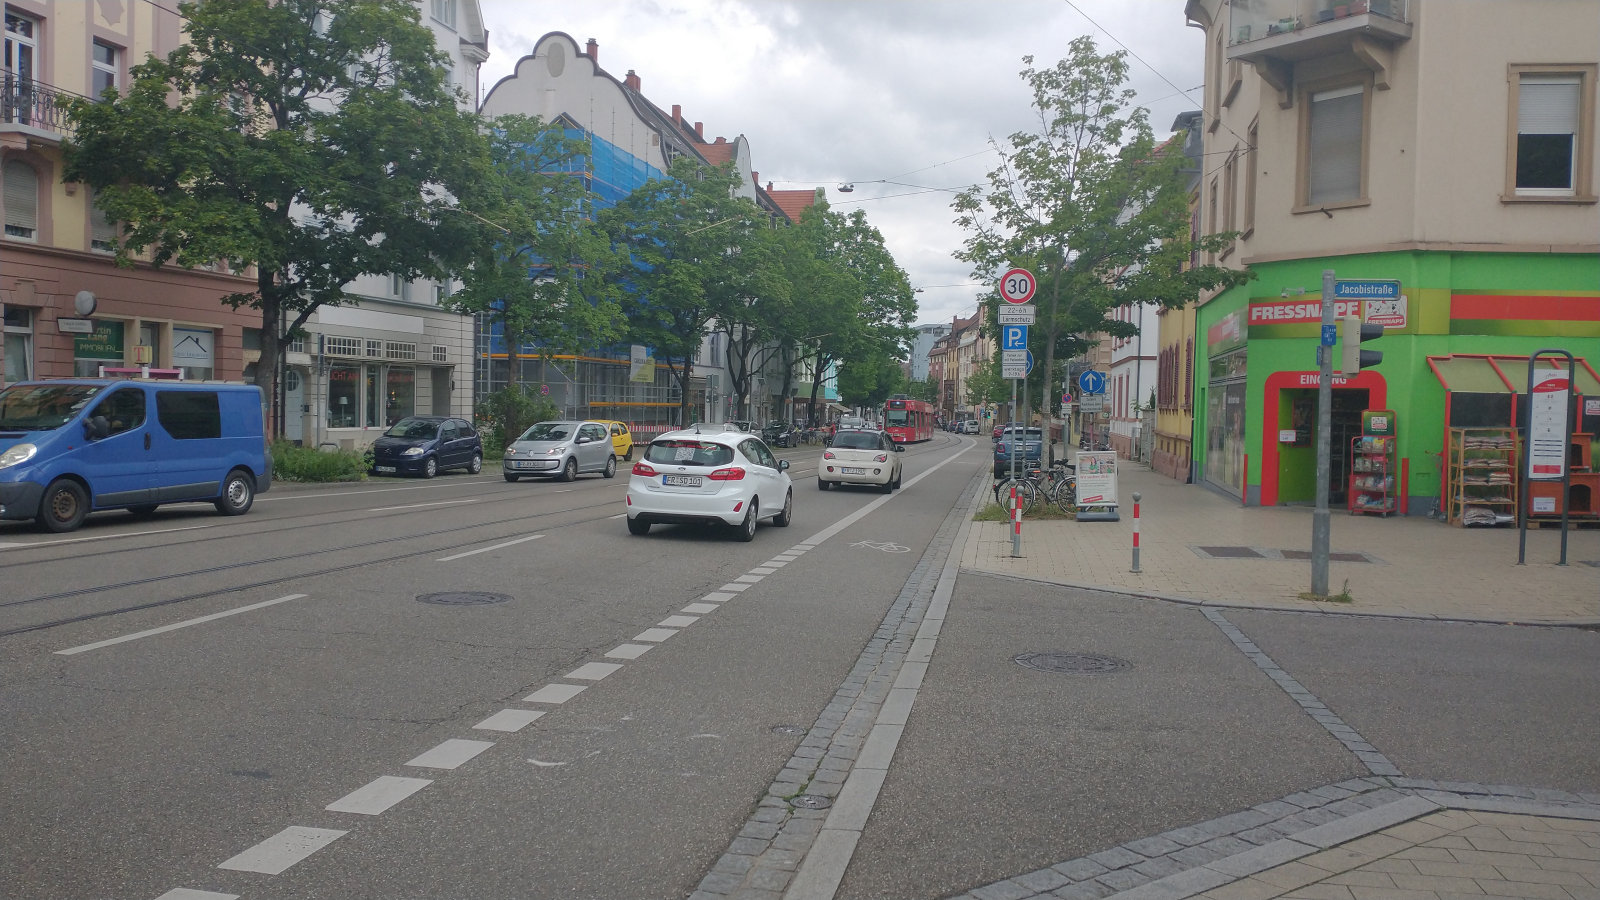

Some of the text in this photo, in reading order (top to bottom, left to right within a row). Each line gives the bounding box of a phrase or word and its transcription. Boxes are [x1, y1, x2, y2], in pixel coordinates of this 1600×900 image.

[1007, 278, 1028, 294] 30
[1340, 285, 1393, 295] Jacobistraße
[1251, 302, 1359, 321] FRESSNPF
[1008, 328, 1022, 347] P
[133, 346, 144, 362] T
